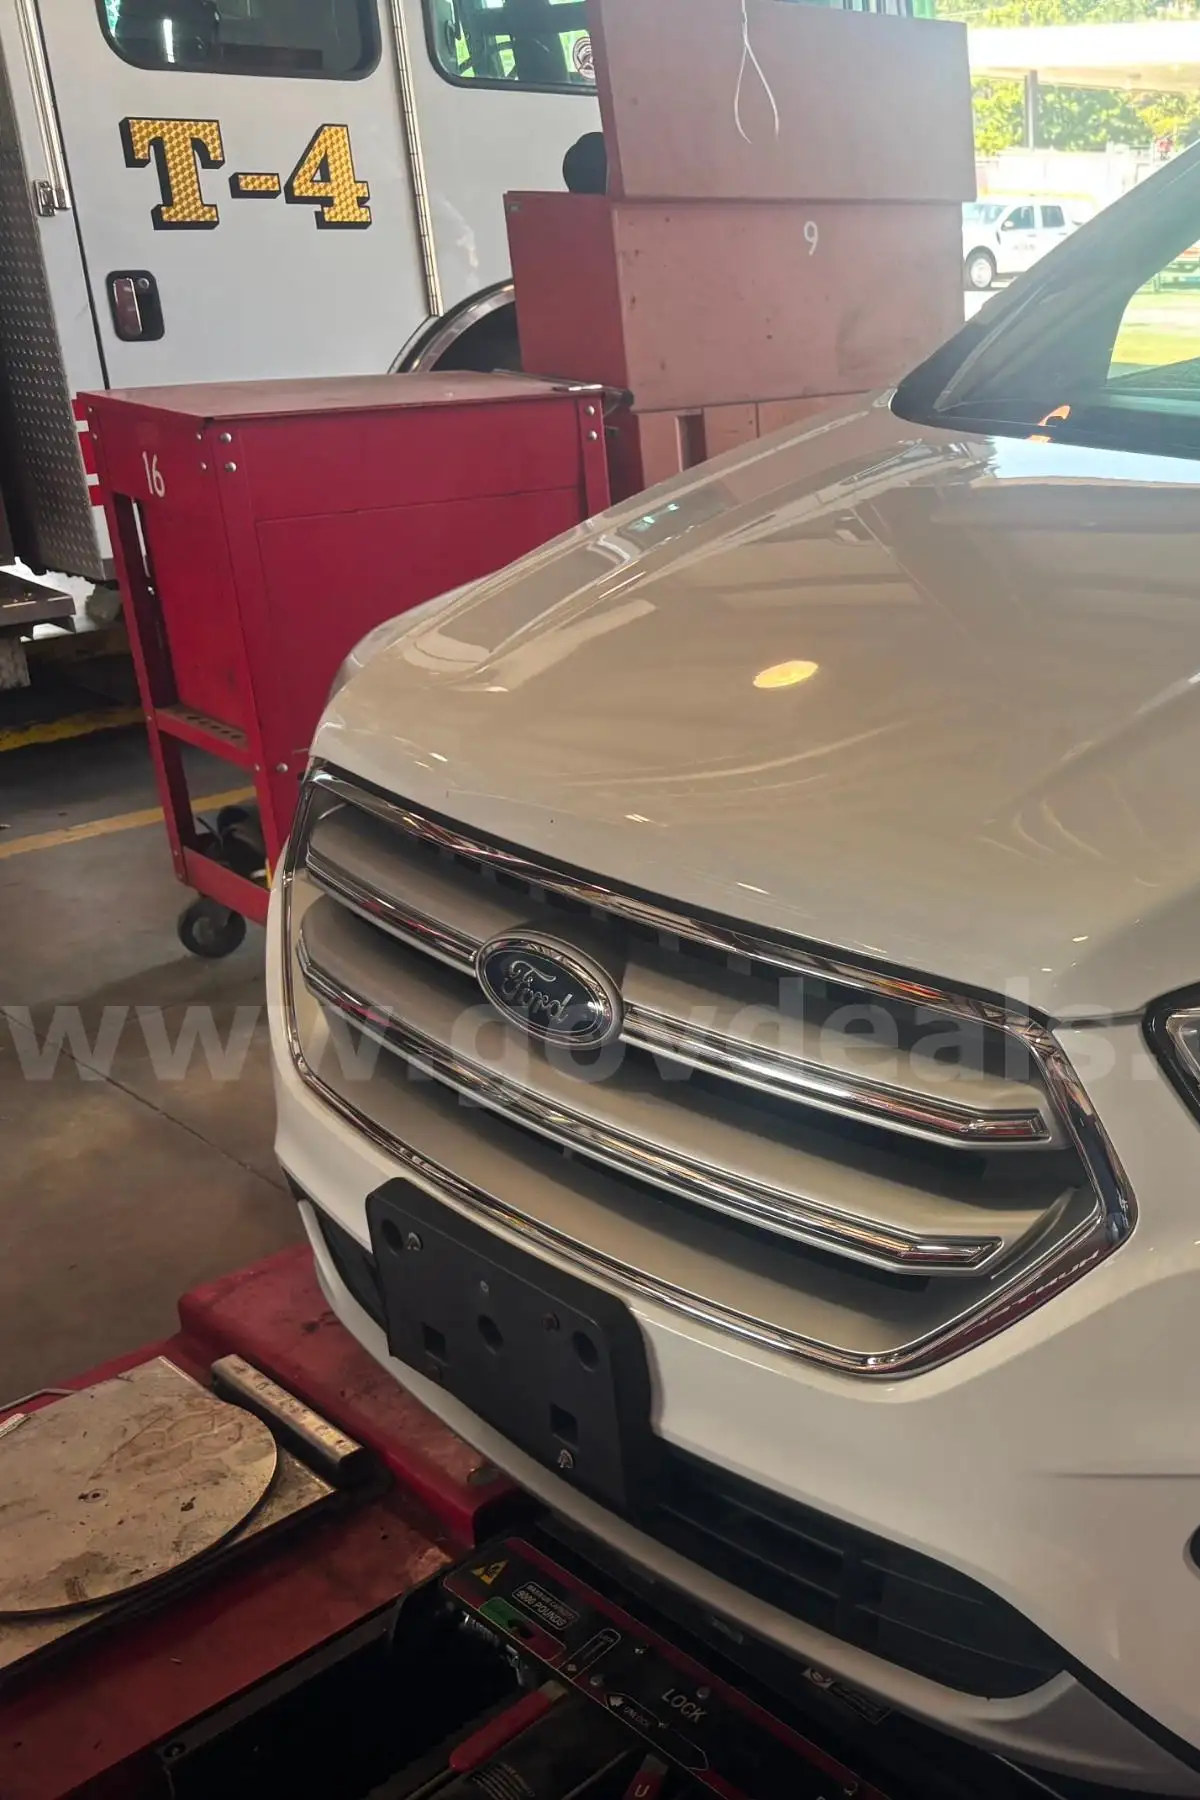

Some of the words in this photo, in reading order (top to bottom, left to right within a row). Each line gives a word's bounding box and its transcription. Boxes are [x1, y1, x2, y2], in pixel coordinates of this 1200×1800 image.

[118, 116, 372, 230] T-4
[803, 220, 818, 256] 9
[142, 451, 165, 498] 16
[501, 960, 573, 1024] Ford
[532, 1601, 568, 1627] POUNDS
[661, 1688, 707, 1723] LOCK
